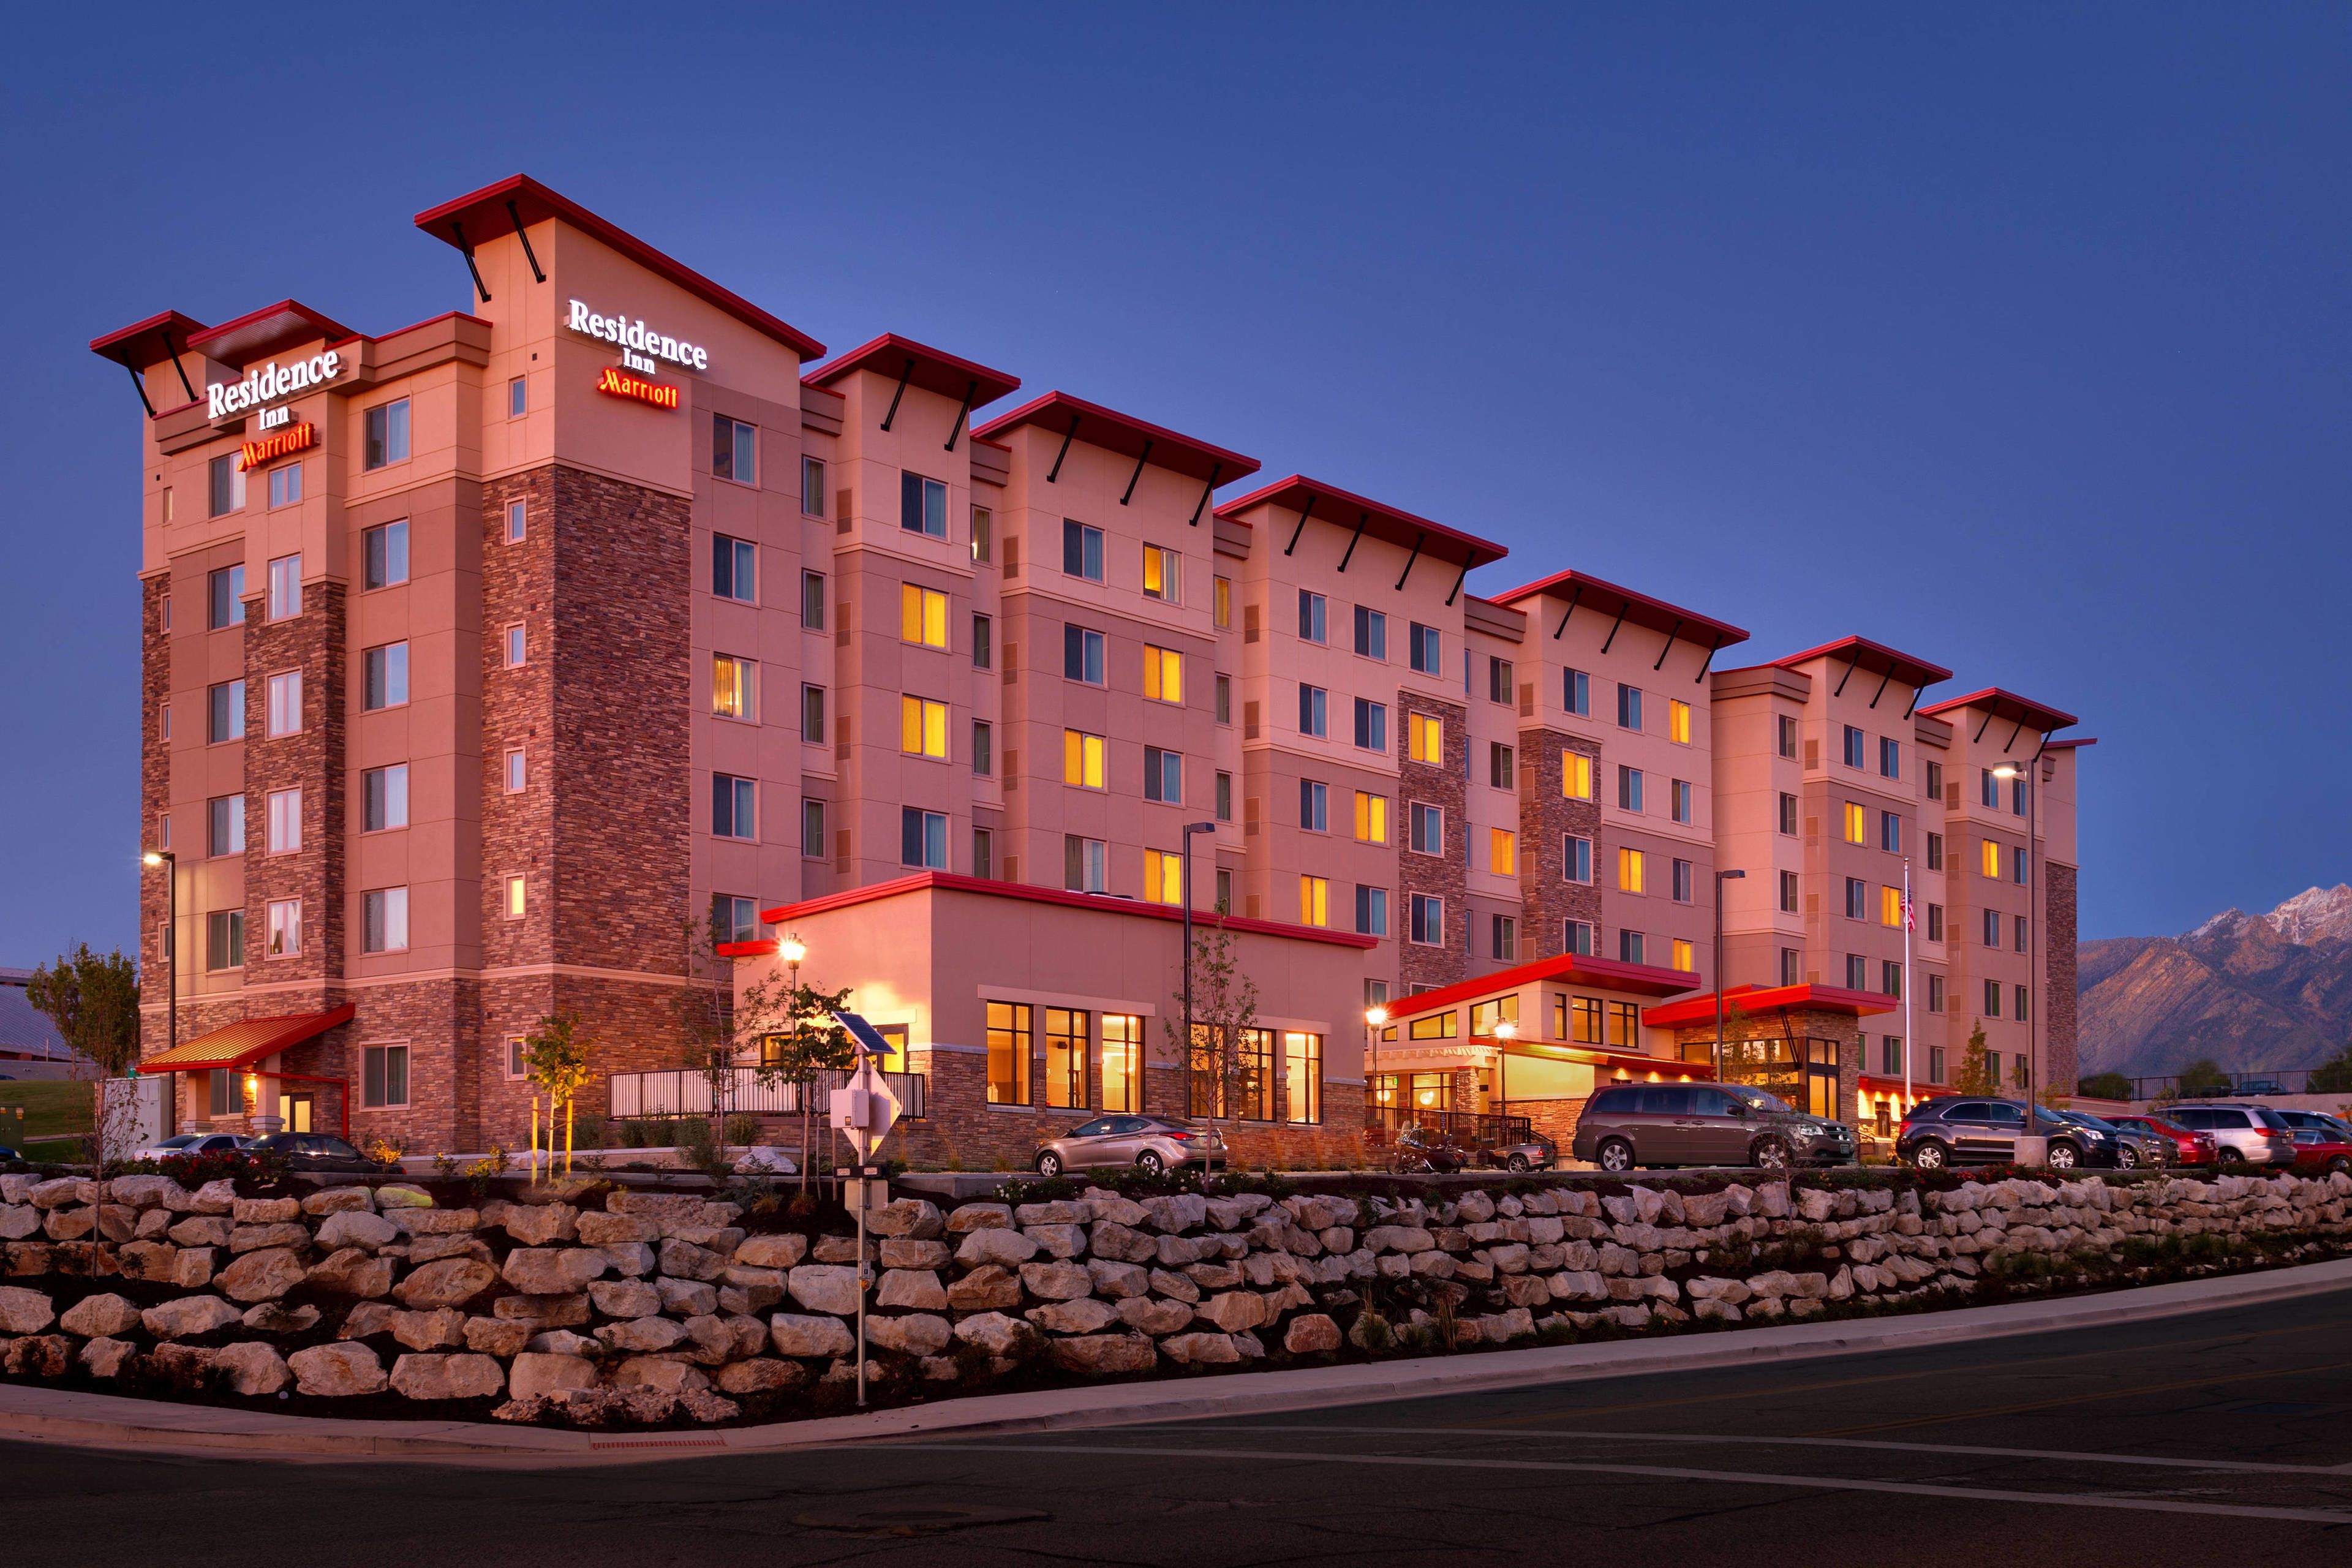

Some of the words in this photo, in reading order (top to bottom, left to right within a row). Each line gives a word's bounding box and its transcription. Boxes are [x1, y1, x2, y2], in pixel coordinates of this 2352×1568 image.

[569, 299, 708, 370] Residence
[623, 347, 656, 375] Inn
[207, 351, 338, 420] Residence
[599, 369, 677, 407] Marriott
[258, 406, 290, 431] Inn
[237, 423, 311, 472] Marriott
